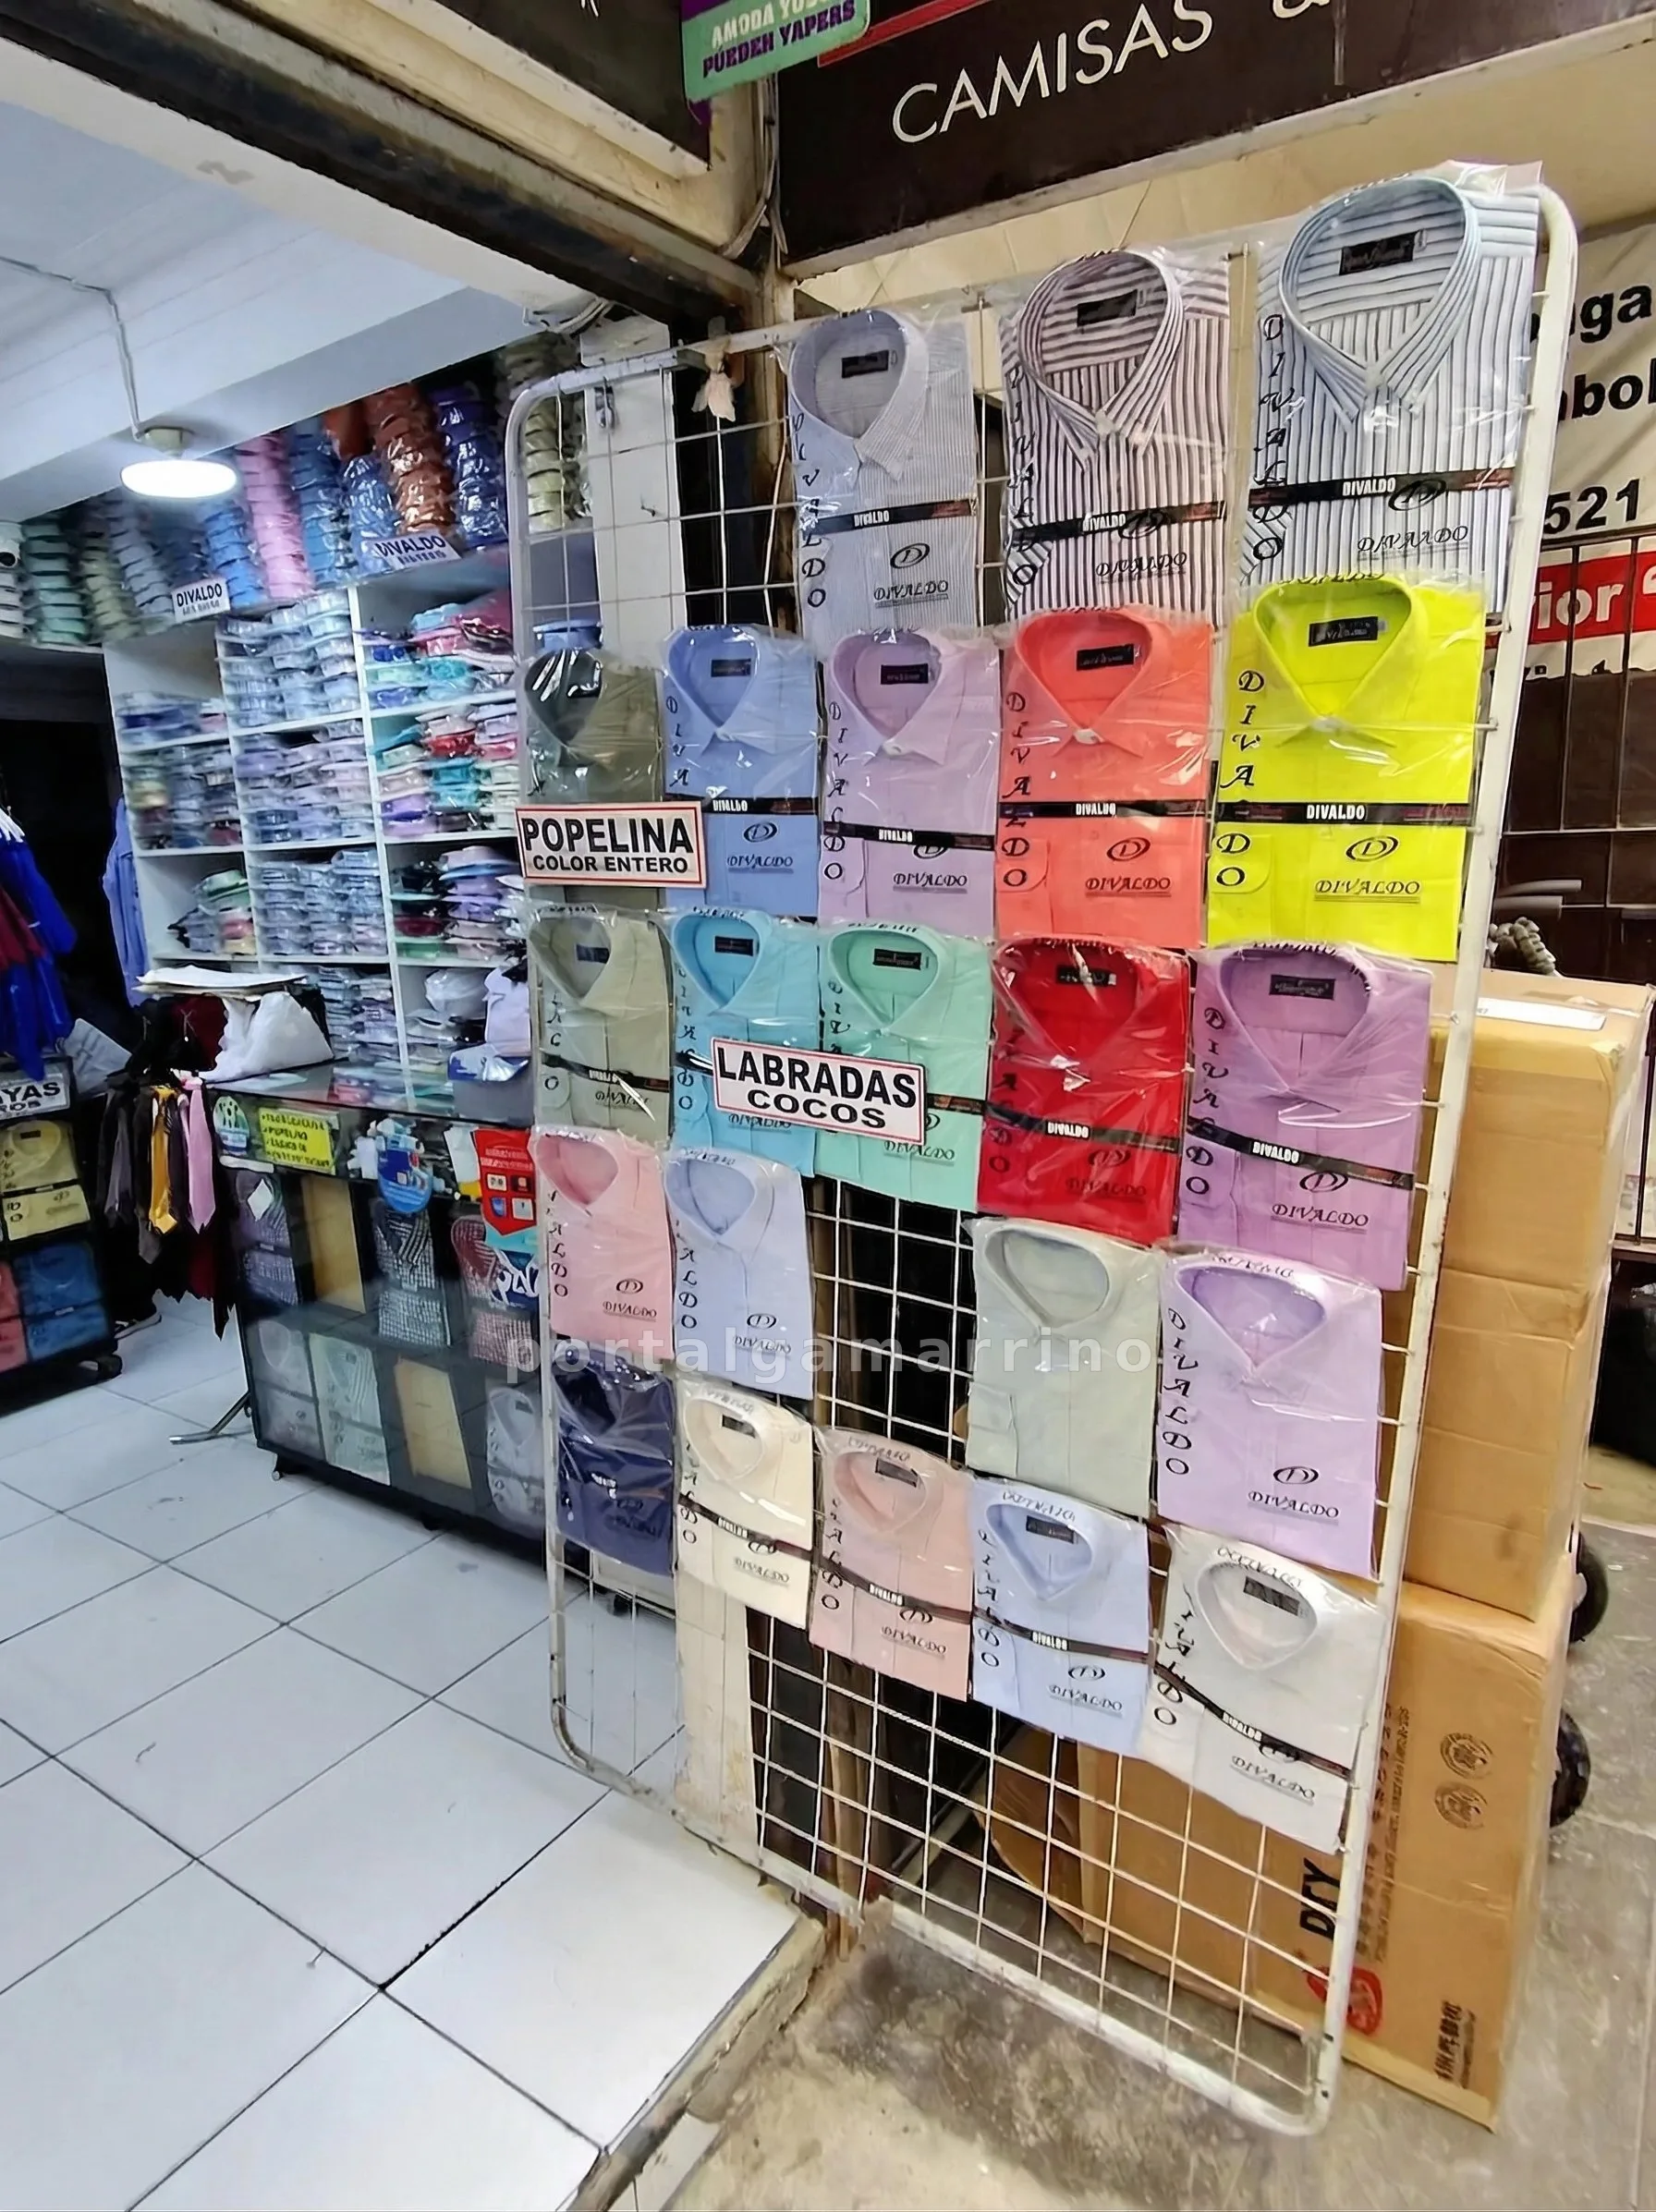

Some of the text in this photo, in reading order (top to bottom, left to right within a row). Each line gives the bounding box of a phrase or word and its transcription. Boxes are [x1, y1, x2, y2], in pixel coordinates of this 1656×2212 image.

[892, 0, 1213, 143] CAMISAS
[1342, 477, 1397, 497] DIVALDO
[1542, 479, 1640, 534] 521
[177, 583, 223, 607] DIVALDO
[1533, 581, 1625, 630] ior
[1216, 670, 1265, 887] DIVADO
[1075, 803, 1116, 817] DIVALDO
[1306, 804, 1367, 820] DIVALDO
[520, 817, 694, 855] POPELINA
[743, 820, 778, 843] D
[1106, 836, 1151, 861] D
[1346, 835, 1399, 861] D
[532, 855, 688, 874] COLOR ENTERO
[893, 872, 968, 887] DIVALDO
[1085, 876, 1172, 892] DIVALDO
[1314, 879, 1421, 895] DIVALDO
[716, 1047, 918, 1108] LABRADAS
[747, 1088, 886, 1130] COCOS
[1186, 1006, 1229, 1196] DIVADO
[1252, 1140, 1300, 1164] DIVALDO
[1272, 1203, 1370, 1227] DIVALDO
[1248, 1490, 1340, 1519] DIVALDO
